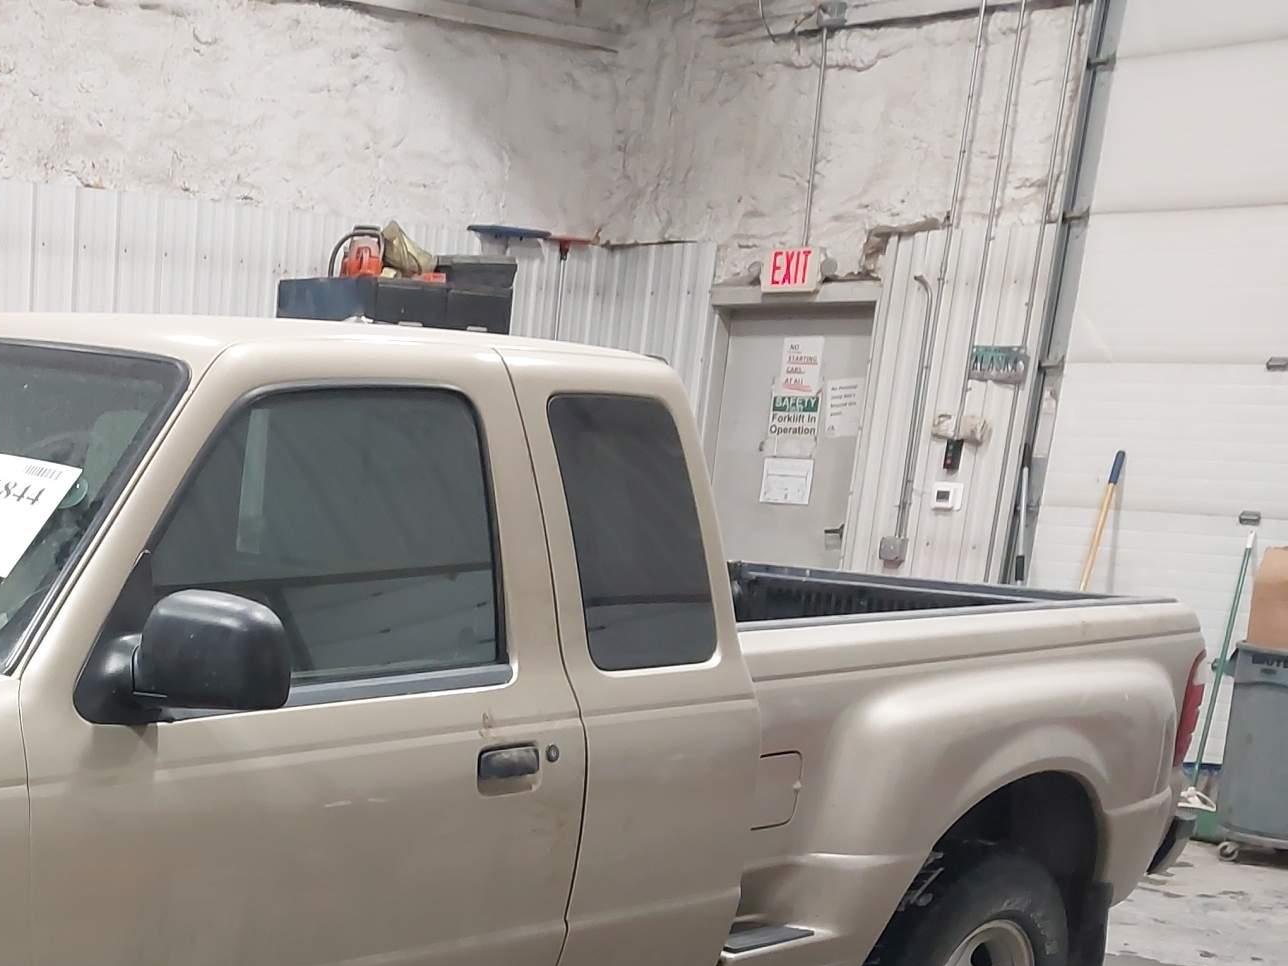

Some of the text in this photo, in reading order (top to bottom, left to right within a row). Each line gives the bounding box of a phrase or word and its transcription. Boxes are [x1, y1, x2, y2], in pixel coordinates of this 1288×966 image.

[771, 250, 811, 284] EXIT
[772, 413, 817, 424] Forklift In
[769, 424, 816, 436] Operation
